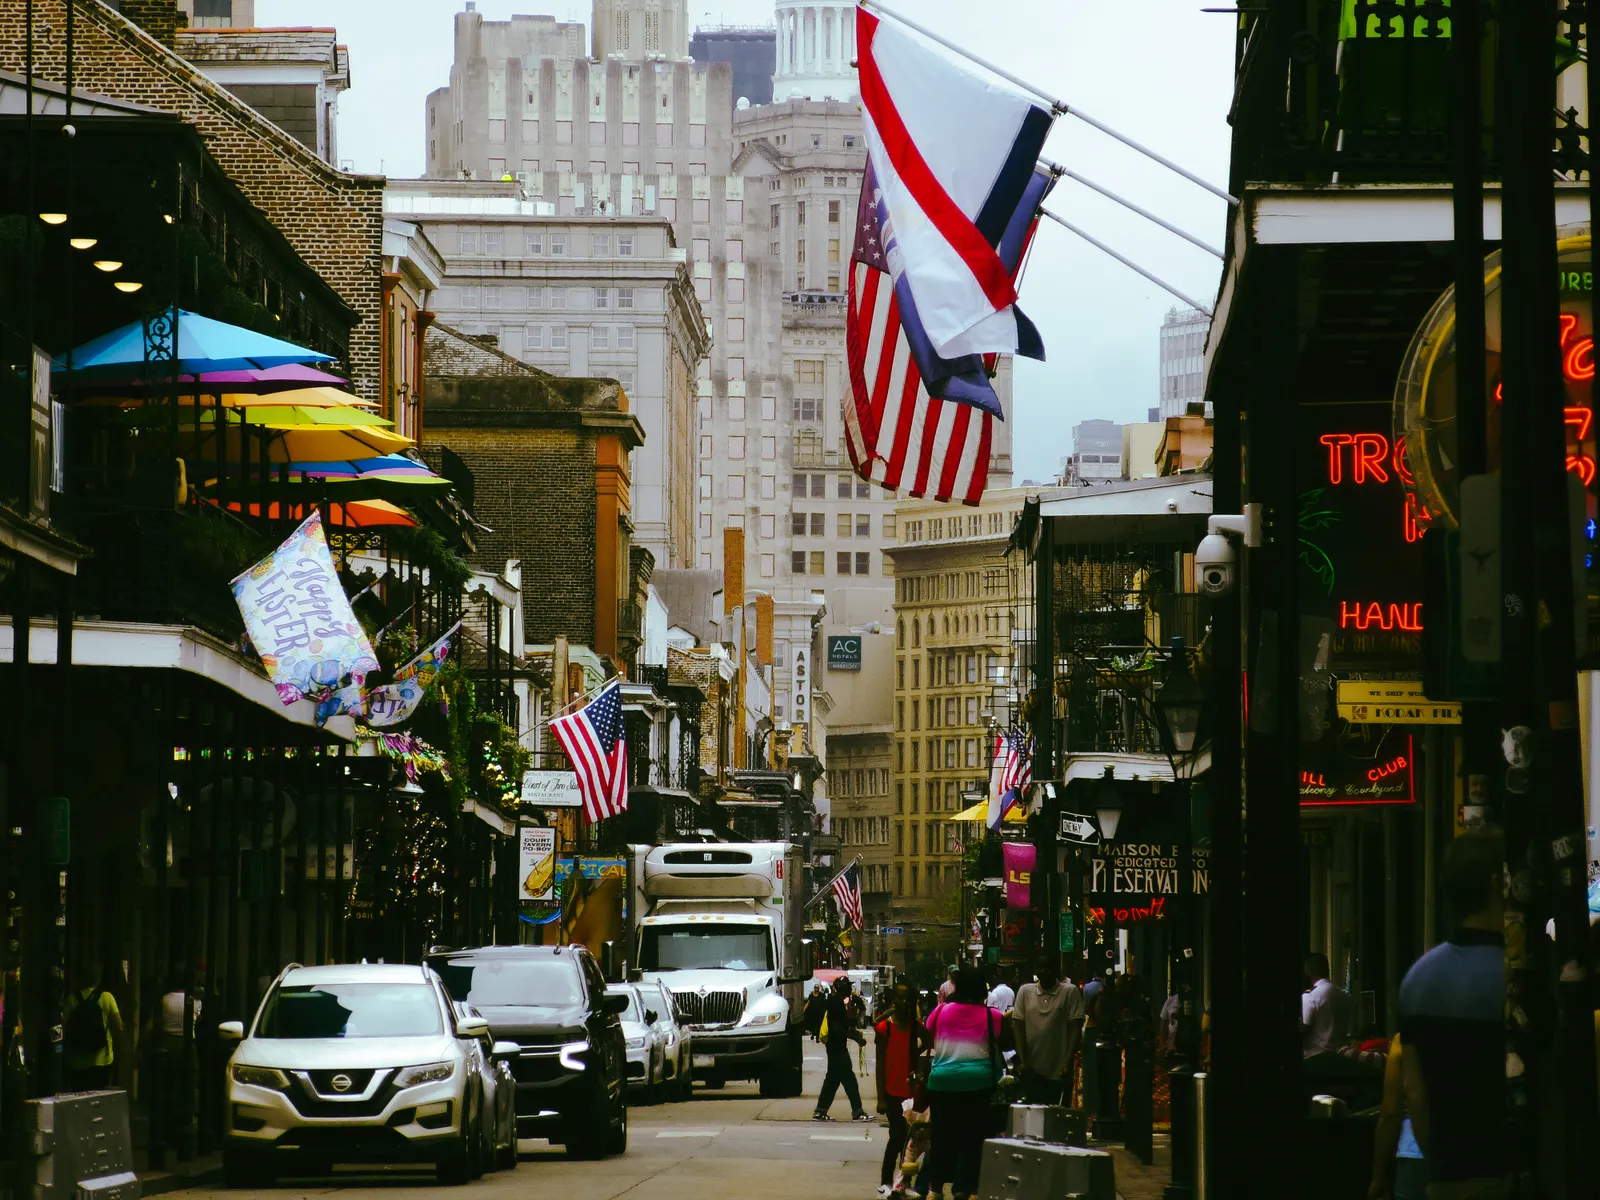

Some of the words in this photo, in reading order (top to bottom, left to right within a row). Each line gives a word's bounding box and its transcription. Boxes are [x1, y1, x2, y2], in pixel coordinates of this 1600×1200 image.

[289, 557, 349, 639] Happy
[254, 569, 311, 658] EASTER
[833, 640, 858, 654] AC
[796, 651, 806, 721] ASTOR
[1375, 708, 1424, 719] KODAK
[1367, 755, 1408, 781] CLUB
[1344, 781, 1405, 798] Courtyard
[1097, 843, 1162, 857] MAISON
[1114, 857, 1177, 869] EDICATED
